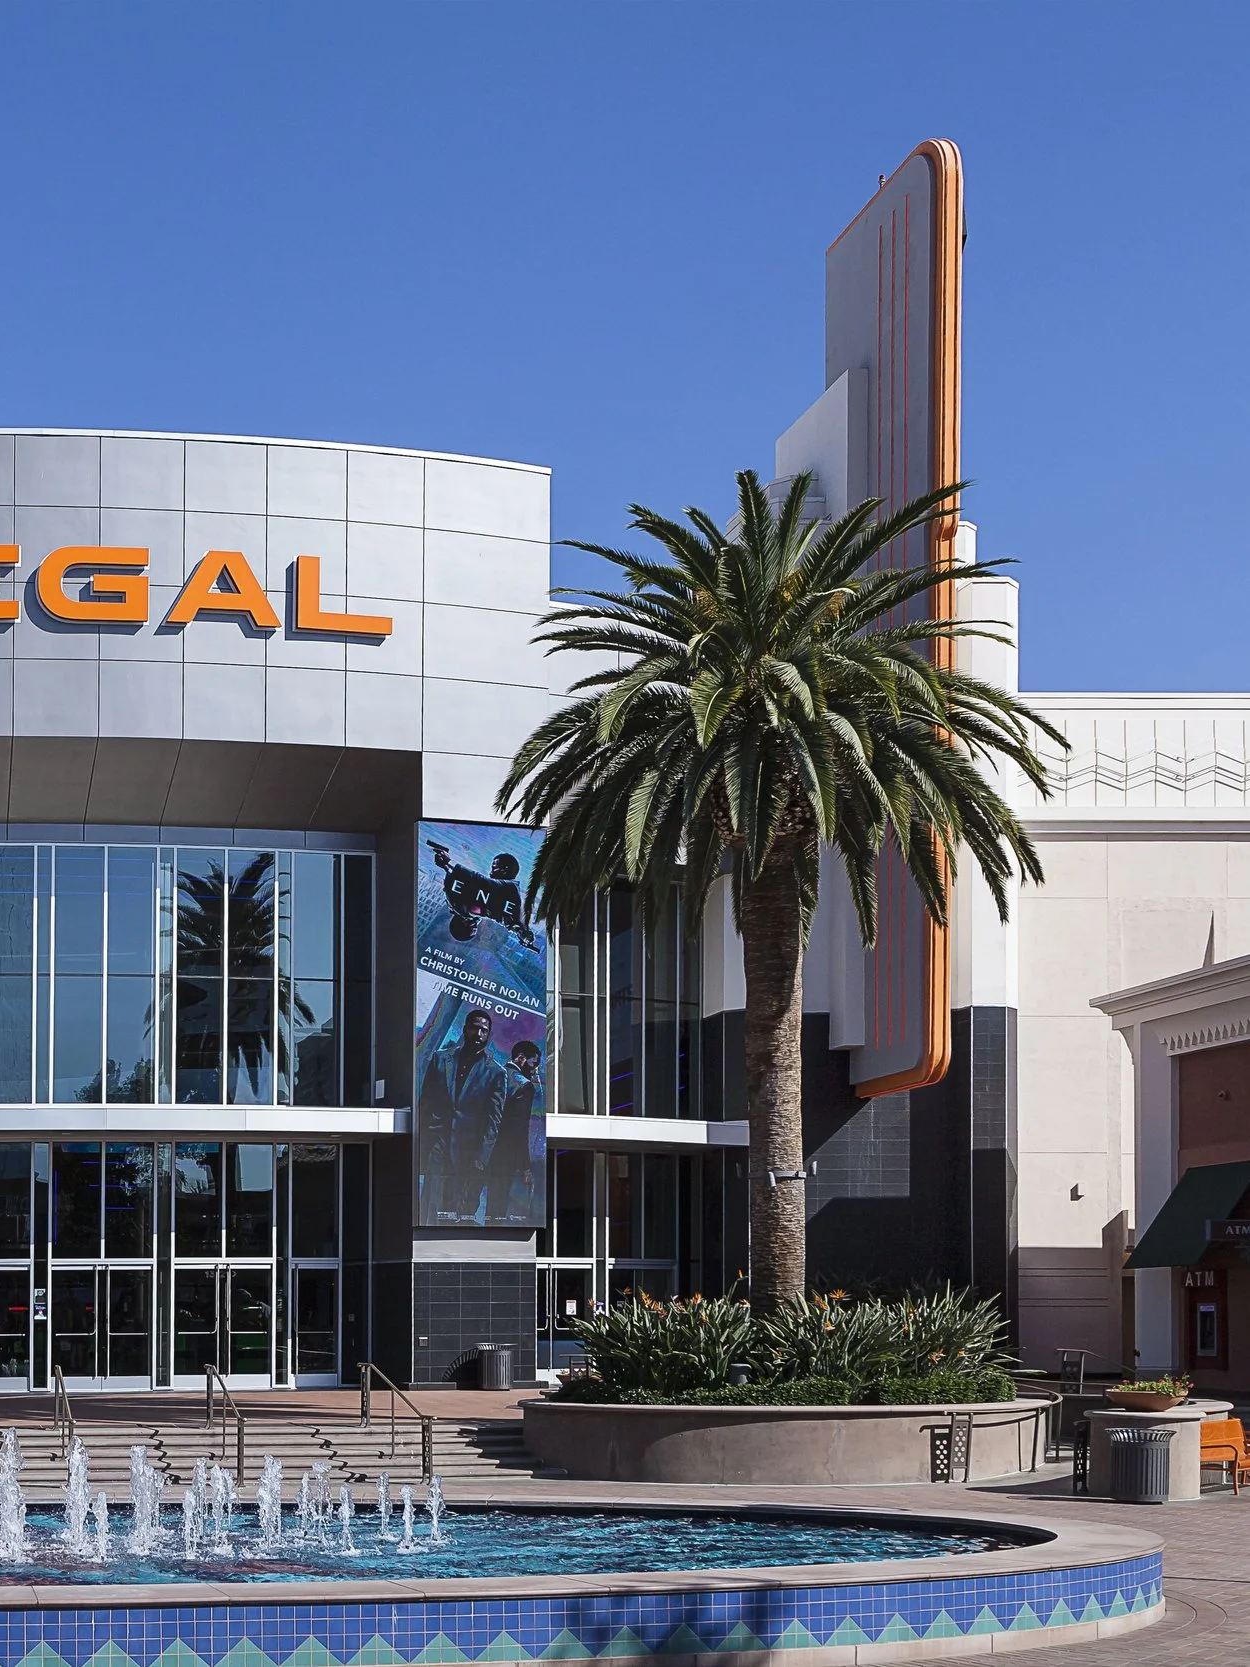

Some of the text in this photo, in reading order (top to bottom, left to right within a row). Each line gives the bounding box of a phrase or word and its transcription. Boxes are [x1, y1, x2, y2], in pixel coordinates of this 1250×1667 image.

[425, 946, 466, 966] A FILM BY
[420, 956, 540, 1008] CHRISTOPHER NOLAN
[461, 991, 493, 1010] RUNS
[494, 1004, 520, 1020] OUT
[1225, 1225, 1250, 1235] ATM
[1185, 1270, 1214, 1287] ATM
